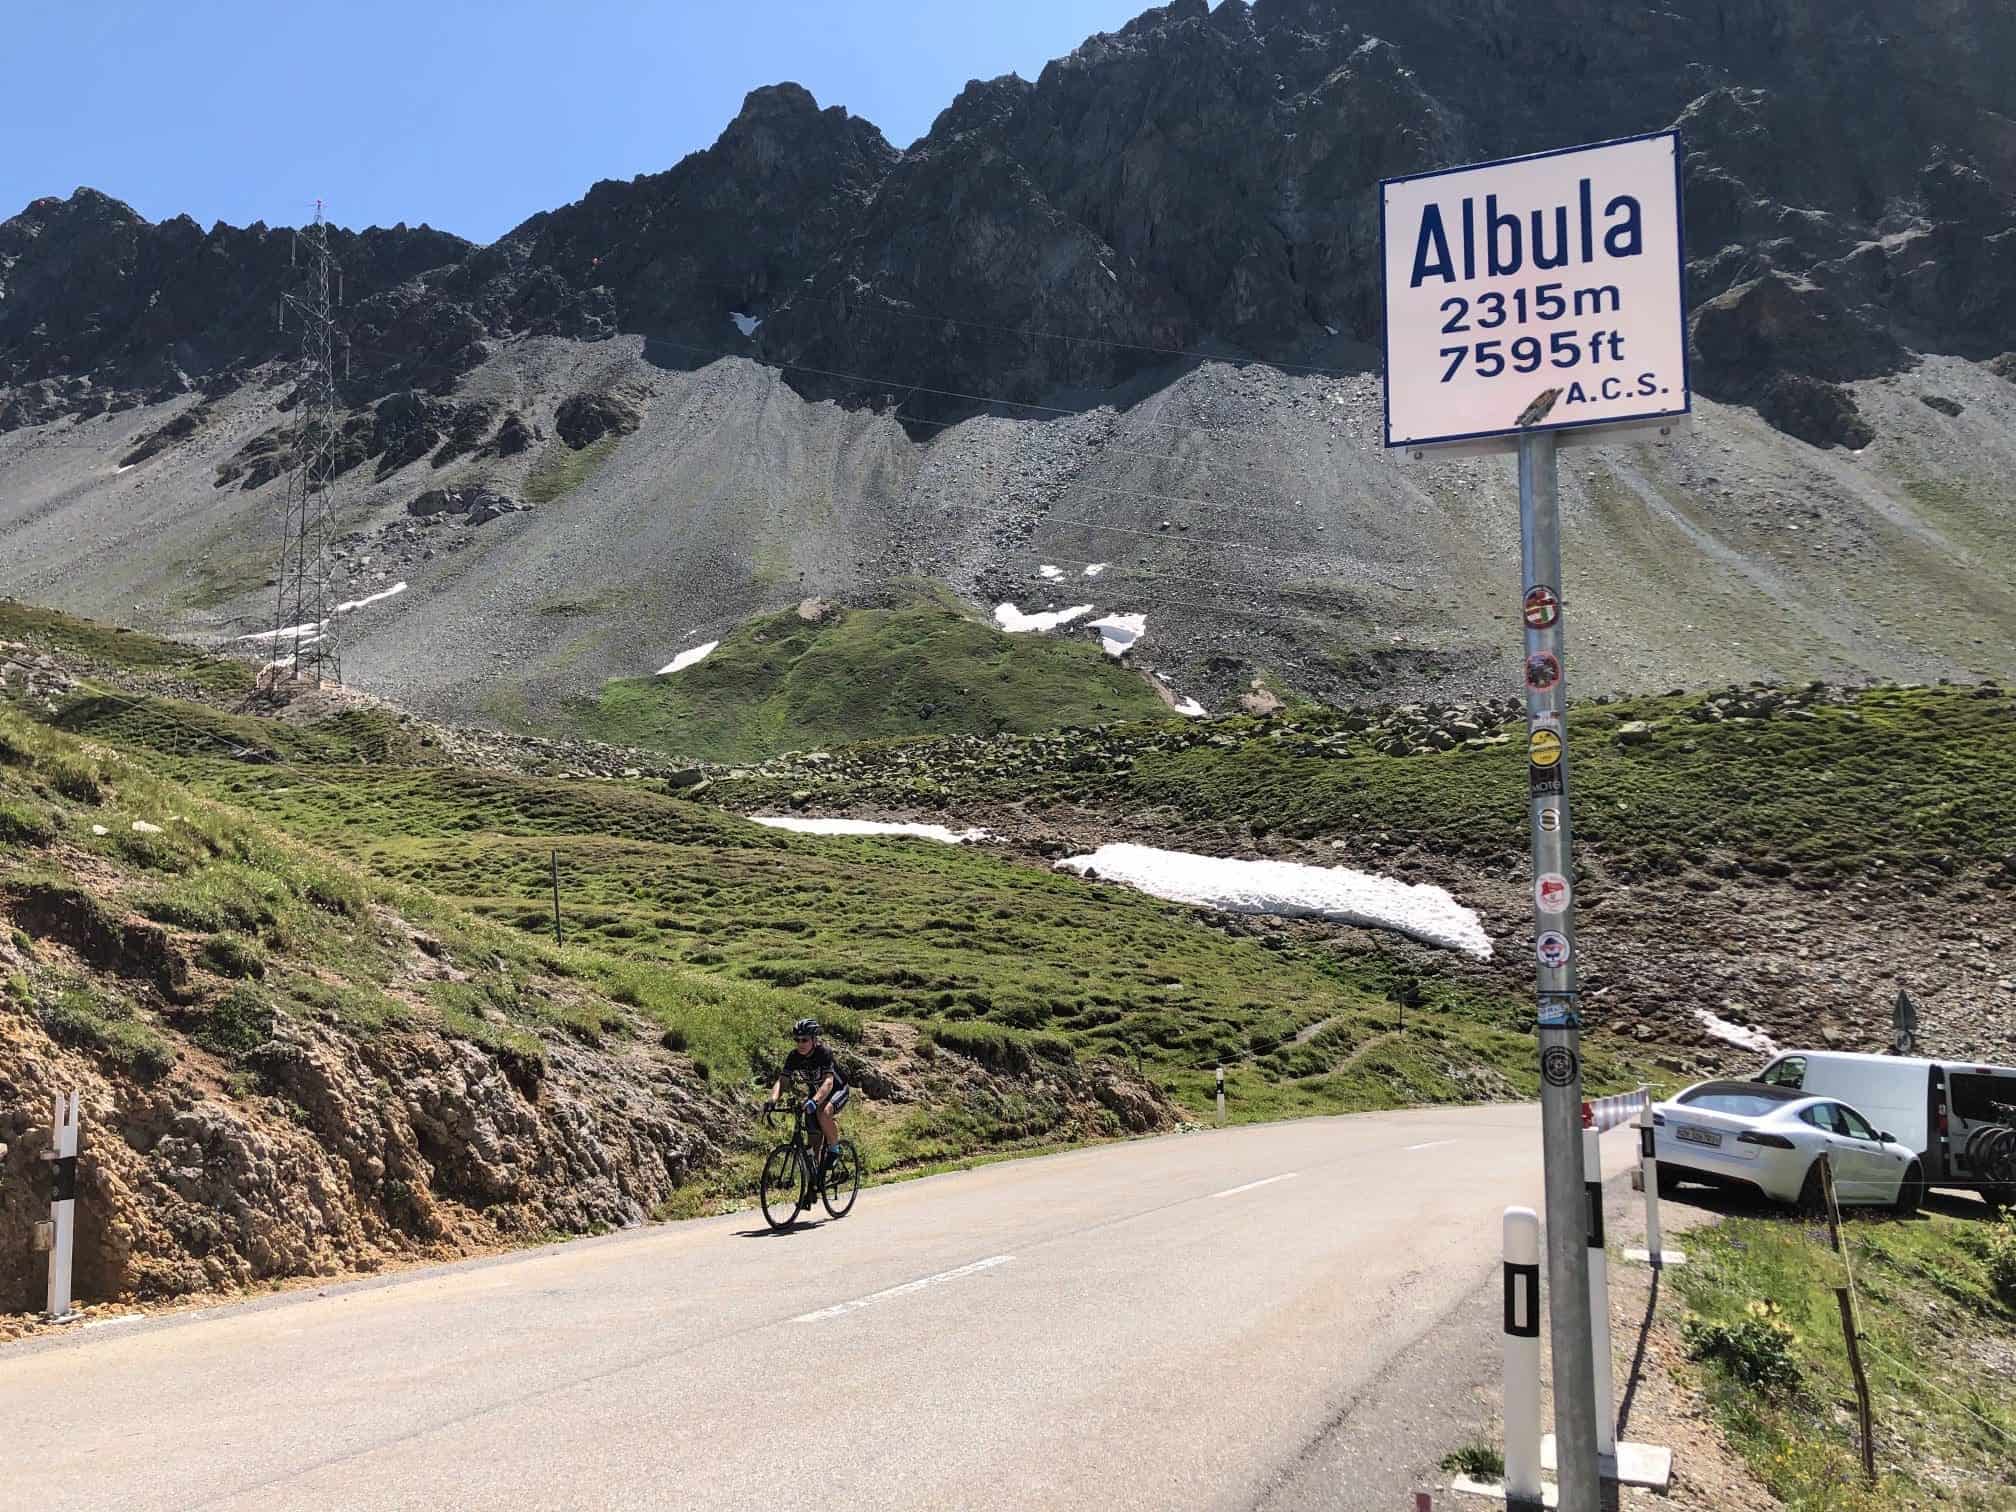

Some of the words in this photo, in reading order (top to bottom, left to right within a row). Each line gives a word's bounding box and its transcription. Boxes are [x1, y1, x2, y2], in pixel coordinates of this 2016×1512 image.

[1410, 178, 1643, 288] Albula
[1440, 284, 1621, 334] 2315m
[1440, 330, 1625, 383] 7595ft
[1566, 373, 1670, 405] A.C.S.
